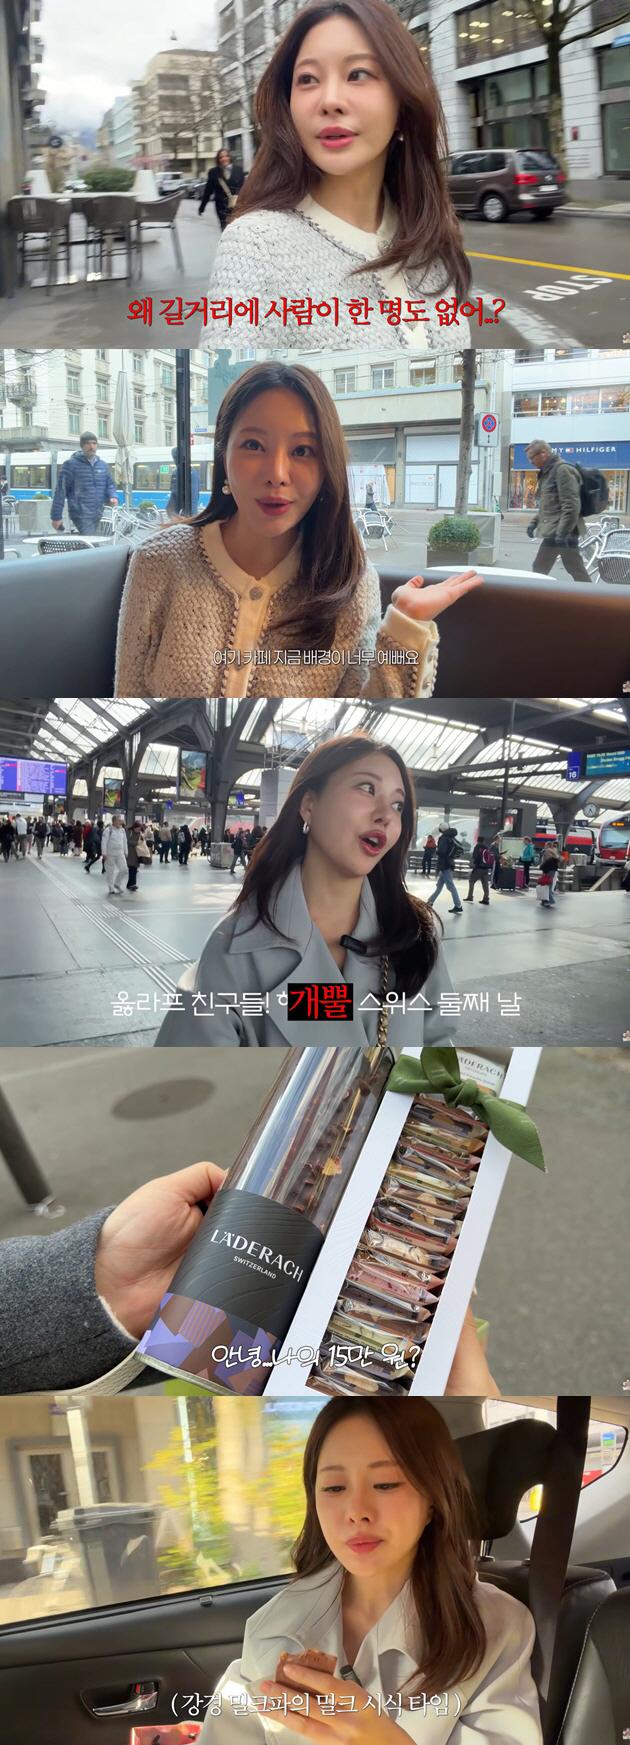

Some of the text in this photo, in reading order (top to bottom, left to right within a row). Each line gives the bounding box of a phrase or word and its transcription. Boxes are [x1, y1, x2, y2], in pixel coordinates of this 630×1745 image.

[522, 274, 614, 302] STOP
[575, 445, 617, 453] HILFIGER
[568, 771, 577, 779] 16
[458, 1056, 503, 1079] ÄDERACH
[210, 1229, 304, 1283] LÄDERACH
[233, 1255, 277, 1280] SWITZERLAND
